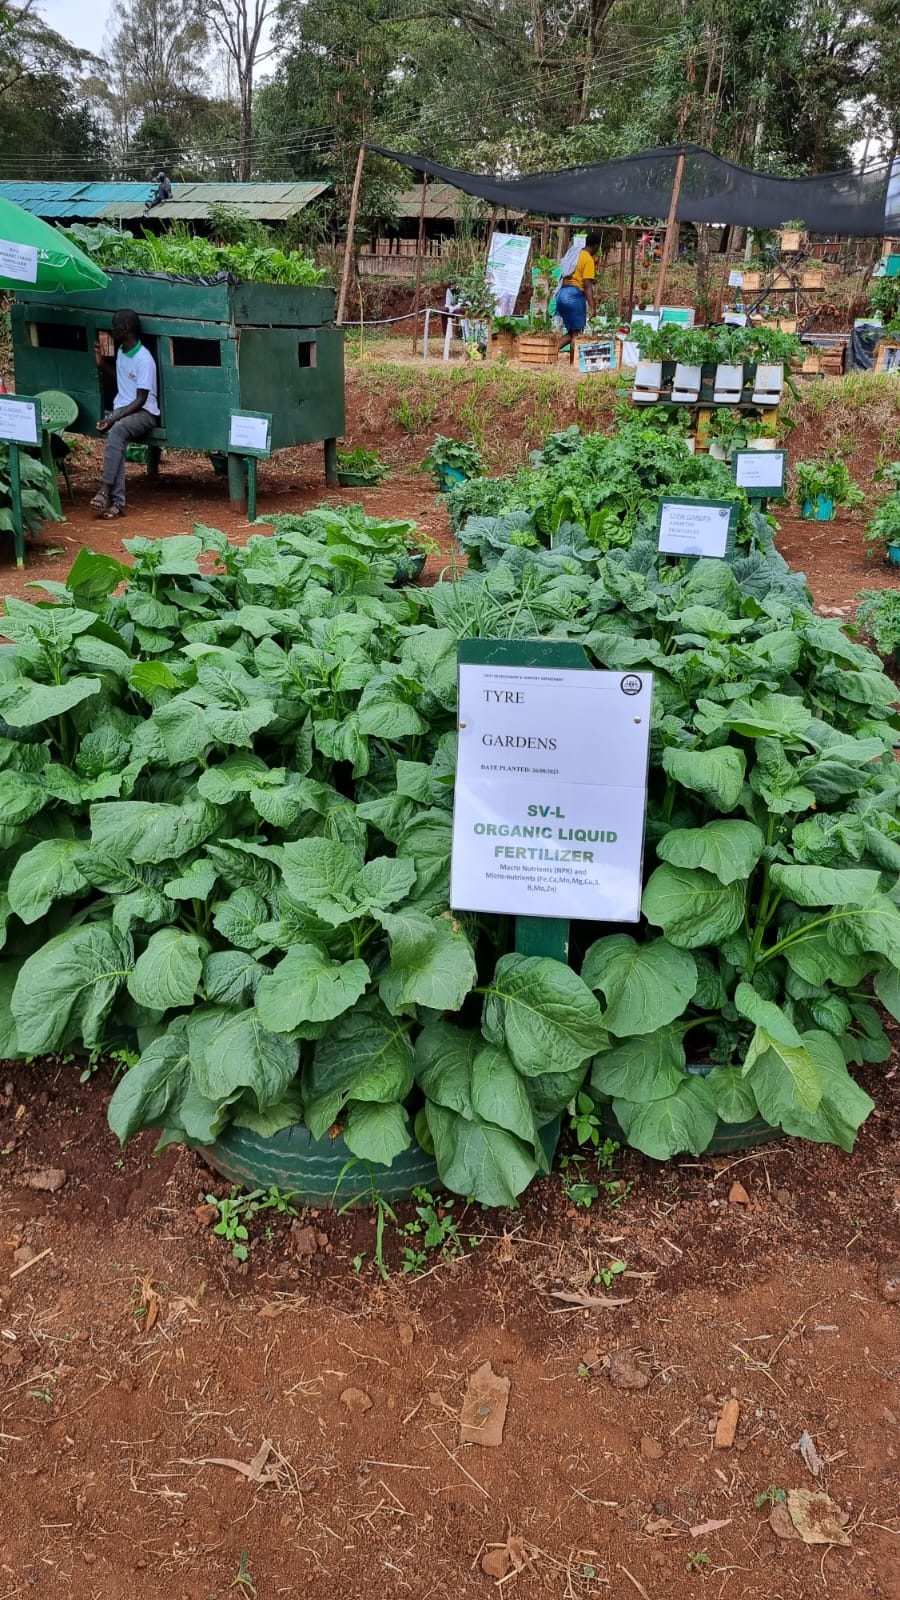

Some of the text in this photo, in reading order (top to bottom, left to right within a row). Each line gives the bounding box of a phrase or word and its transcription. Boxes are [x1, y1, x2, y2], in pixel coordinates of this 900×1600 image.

[483, 689, 525, 704] TYRE
[482, 734, 557, 750] GARDENS
[527, 805, 566, 818] SV-L
[473, 822, 618, 843] ORGANIC LIQUID
[494, 845, 594, 863] FERTILIZER
[485, 872, 536, 882] Micro-nutrients
[499, 864, 521, 872] Macro
[522, 865, 553, 874] Nutrients
[554, 867, 573, 875] (NPK)
